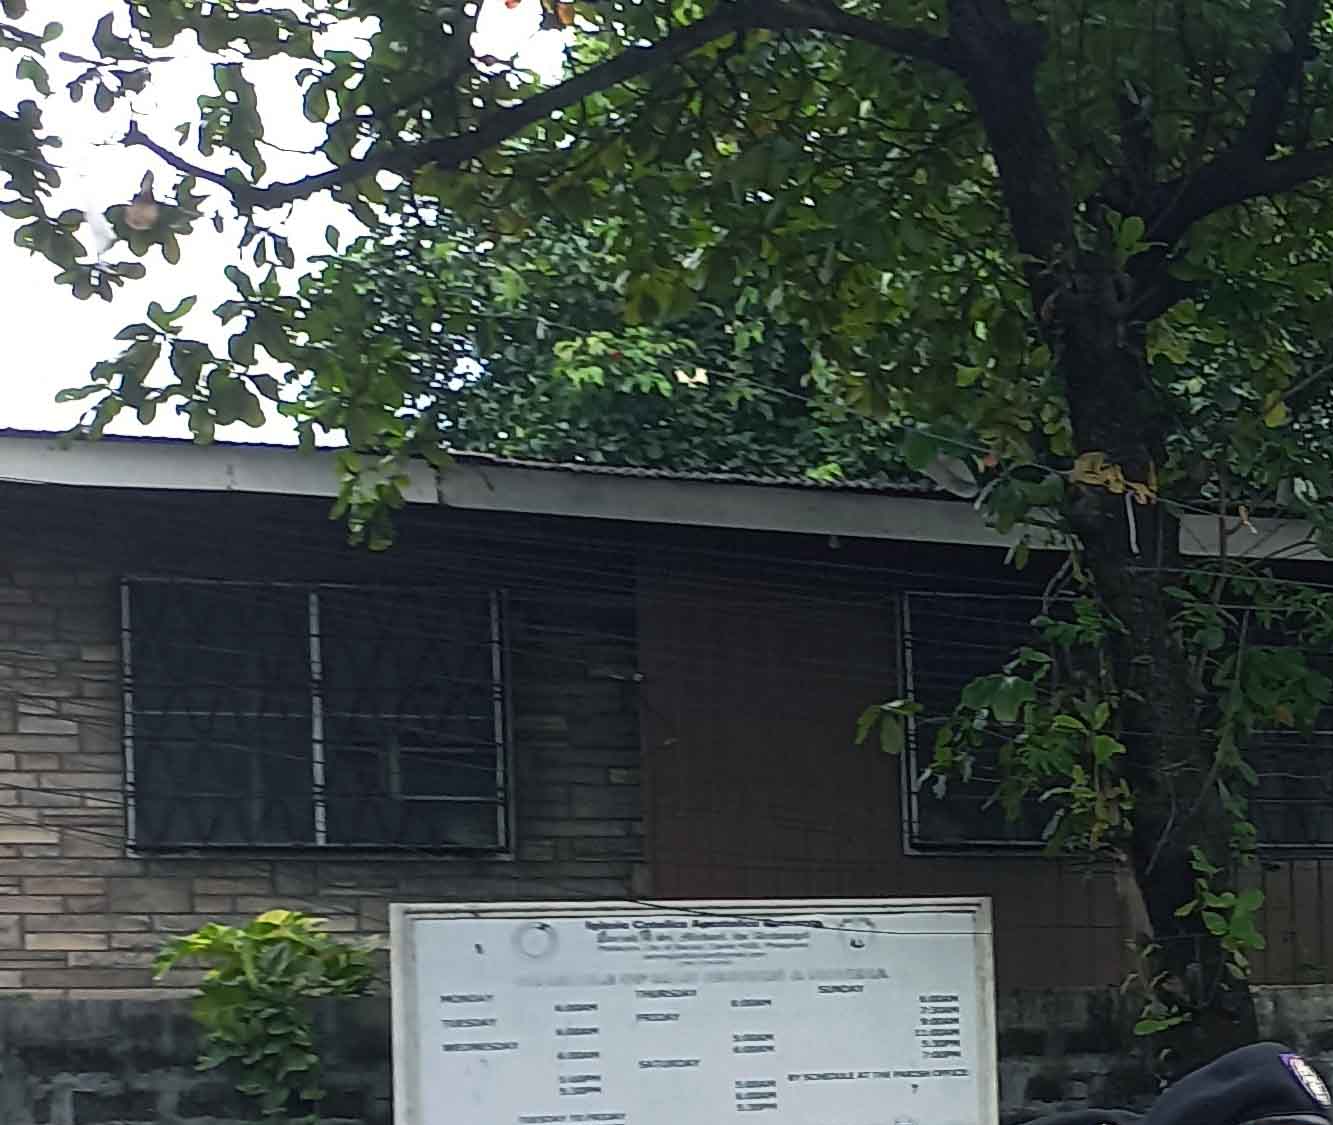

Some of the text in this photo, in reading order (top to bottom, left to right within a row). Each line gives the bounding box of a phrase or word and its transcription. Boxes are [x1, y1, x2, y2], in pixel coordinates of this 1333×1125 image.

[635, 989, 697, 998] THURSDAY
[817, 985, 864, 993] SUNDAY
[440, 994, 494, 1003] MONDAY
[635, 1013, 680, 1022] FRIDAY
[441, 1018, 497, 1027] TUESDAY
[442, 1042, 518, 1052] WEDNESDAY
[638, 1059, 700, 1069] SATURDAY
[803, 1072, 855, 1081] SCHEDULE
